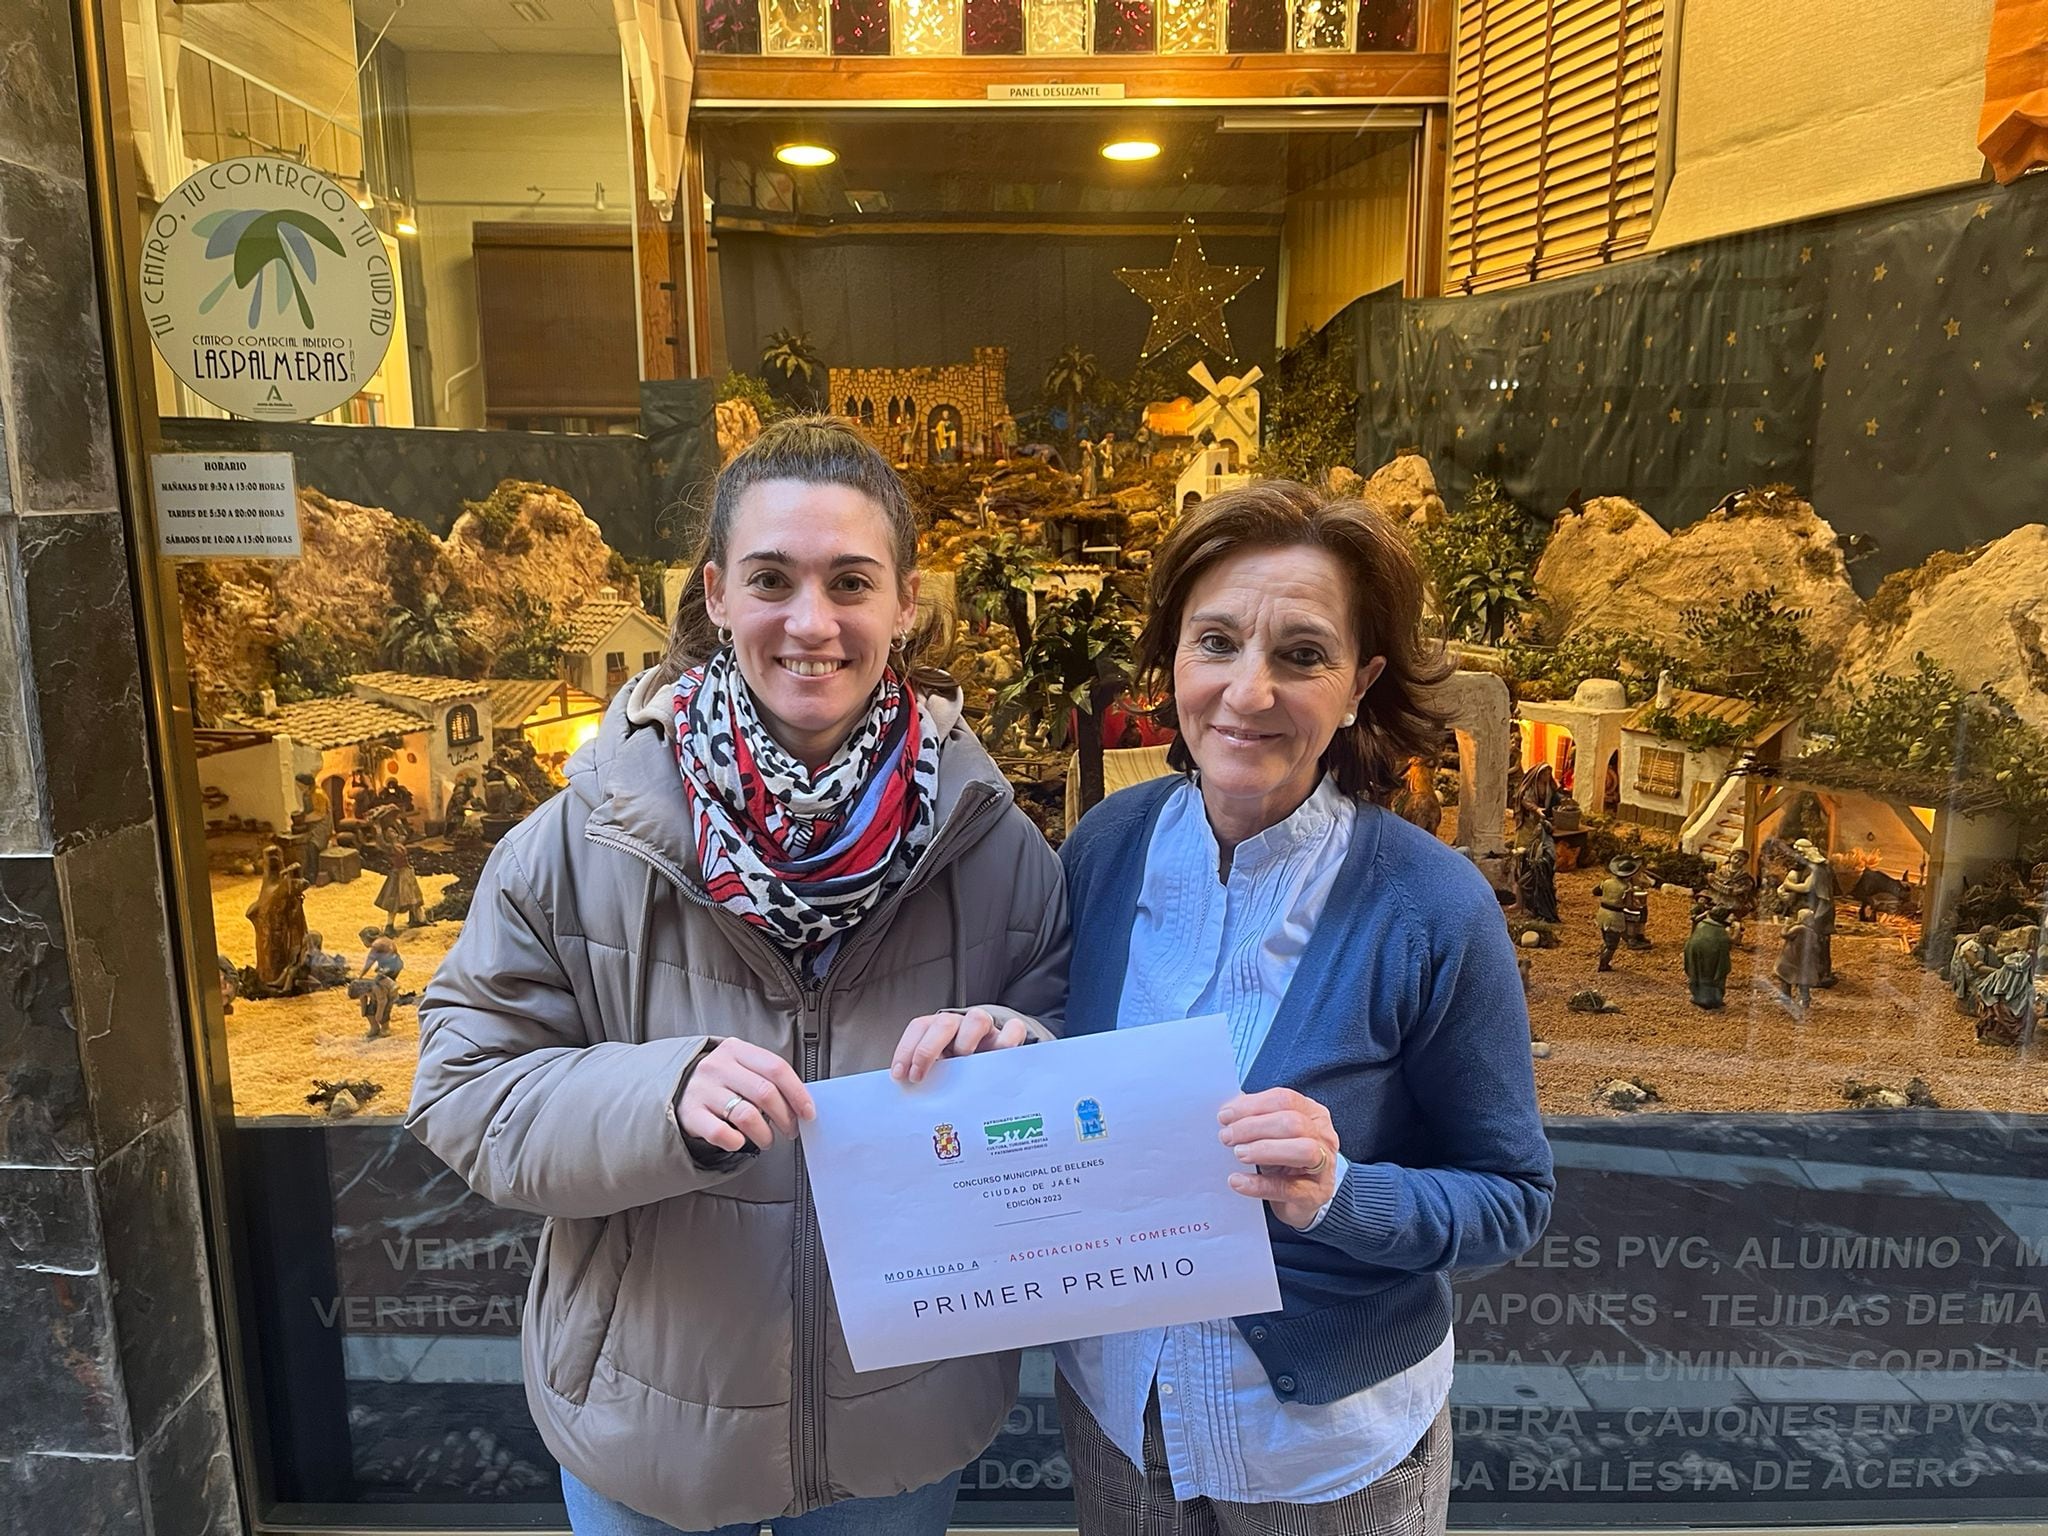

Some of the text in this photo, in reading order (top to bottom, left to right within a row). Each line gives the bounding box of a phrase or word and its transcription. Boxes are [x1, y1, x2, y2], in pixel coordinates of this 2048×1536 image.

[1009, 86, 1101, 97] PANEL DESLIZANTE
[150, 313, 175, 339] TU
[179, 180, 206, 207] TU
[351, 220, 377, 248] TU
[367, 254, 393, 337] CIUDAD
[192, 335, 345, 349] CENTRO COMERCIAL ABIERTO
[204, 461, 247, 471] HORARIO
[161, 482, 285, 491] MAÑANAS DE 9:30 A 13:00 HORAS
[167, 509, 285, 518] TARDES DE 5:30 A 20:00 HORAS
[166, 534, 293, 544] SÁBADOS DE 10:00 A 13:00 HORAS
[952, 1158, 1105, 1190] CONCURSO MUNICIPAL DE BELENES
[982, 1185, 1027, 1199] CIUDAD
[1032, 1182, 1045, 1191] DE
[1006, 1194, 1063, 1210] EDICIÓN 2023
[884, 1262, 965, 1282] MODALIDAD
[971, 1259, 980, 1269] A
[1009, 1238, 1110, 1263] ASOCIACIONES
[1115, 1236, 1123, 1245] Y
[1129, 1222, 1211, 1243] COMERCIOS
[1617, 1235, 1720, 1274] PVC,
[1733, 1235, 1961, 1269] ALUMINIO
[1975, 1235, 2006, 1267] Y
[913, 1257, 1195, 1318] PRIMER PREMIO
[1701, 1293, 1891, 1326] TEJIDAS
[1906, 1293, 1967, 1325] DE
[1979, 1292, 2047, 1324] MA
[1583, 1348, 1805, 1382] ALUMINIO
[1459, 1405, 1584, 1437] DERA
[1624, 1404, 1838, 1437] CAJONES
[1853, 1404, 1911, 1435] EN
[1926, 1402, 2014, 1434] PVC
[1508, 1461, 1740, 1491] BALLESTA
[1752, 1460, 1813, 1491] DE
[1822, 1457, 1979, 1489] ACERO
